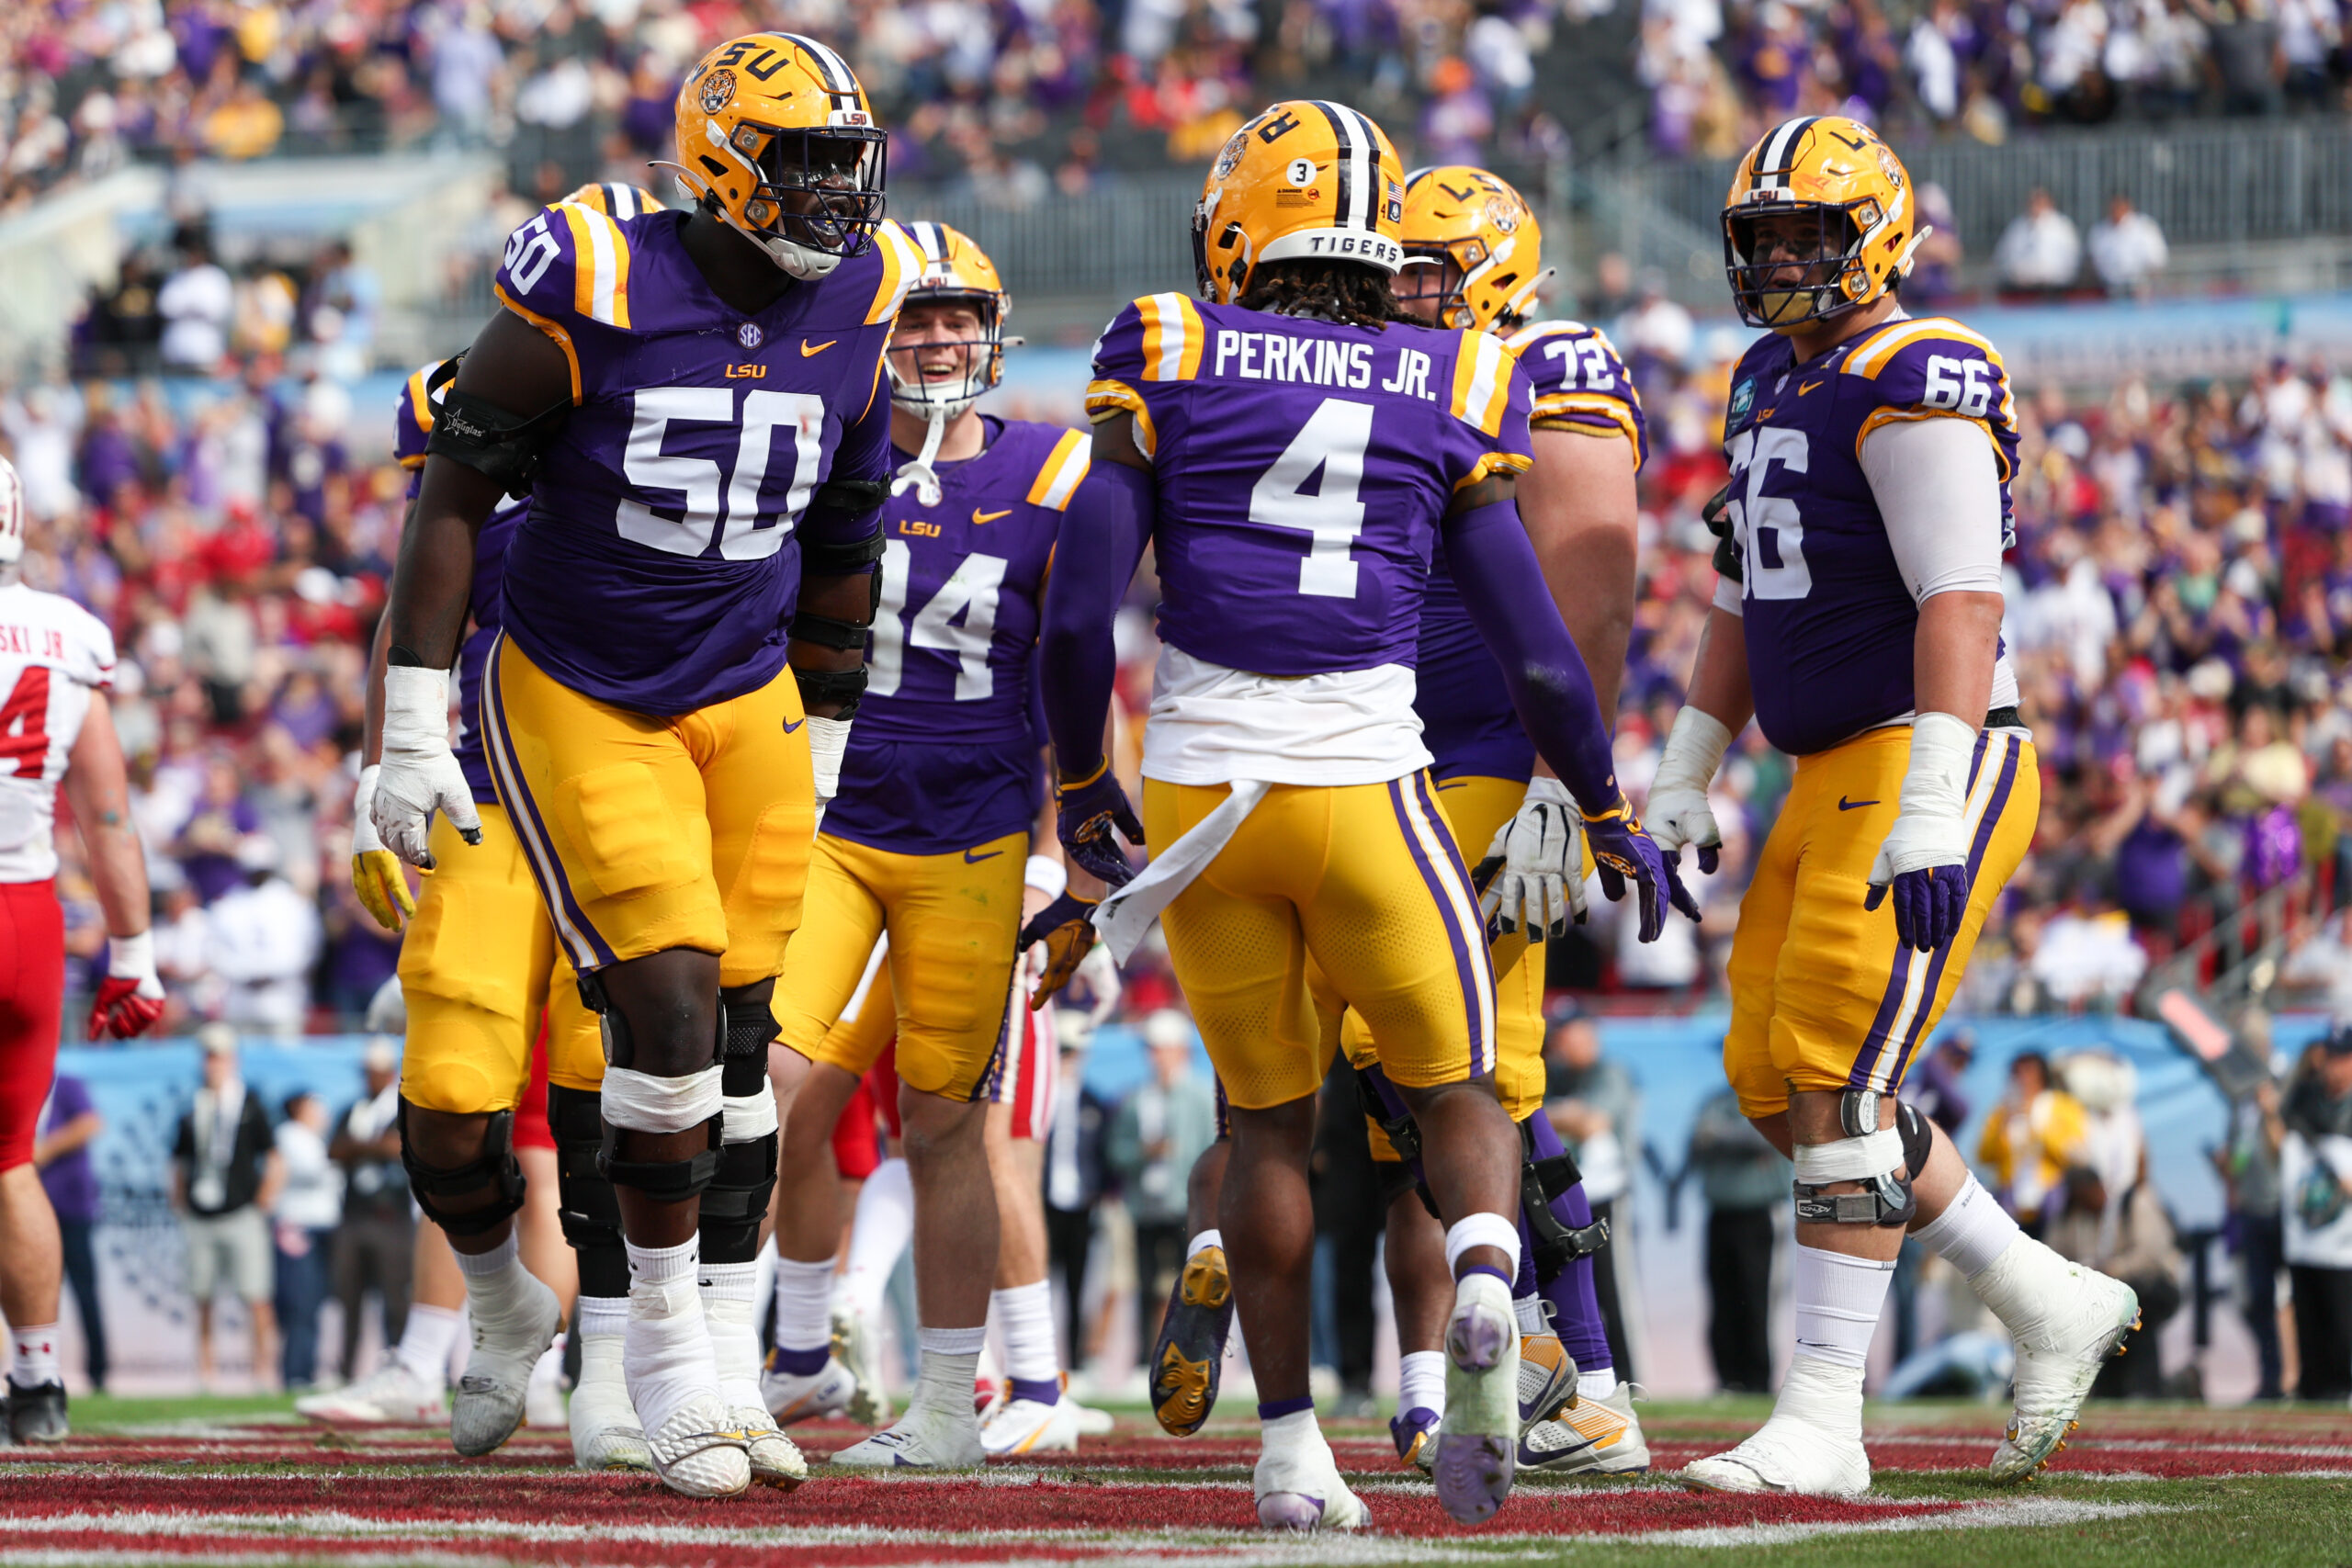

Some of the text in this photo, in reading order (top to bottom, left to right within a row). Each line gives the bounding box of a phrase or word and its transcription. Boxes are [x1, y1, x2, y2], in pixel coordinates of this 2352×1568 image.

[842, 113, 867, 125] LSU
[798, 174, 823, 183] JNES
[1295, 163, 1307, 182] 3
[1380, 203, 1386, 219] 4
[504, 214, 561, 296] 50
[1311, 237, 1398, 262] TIGERS
[740, 323, 762, 347] SEC
[725, 364, 767, 378] LSU
[1215, 330, 1436, 401] PERKINS JR.
[1544, 337, 1615, 390] 72
[1922, 355, 1992, 417] 66
[451, 417, 483, 437] Douglas
[616, 387, 825, 561] 50
[1248, 398, 1374, 599] 4
[899, 520, 942, 537] LSU
